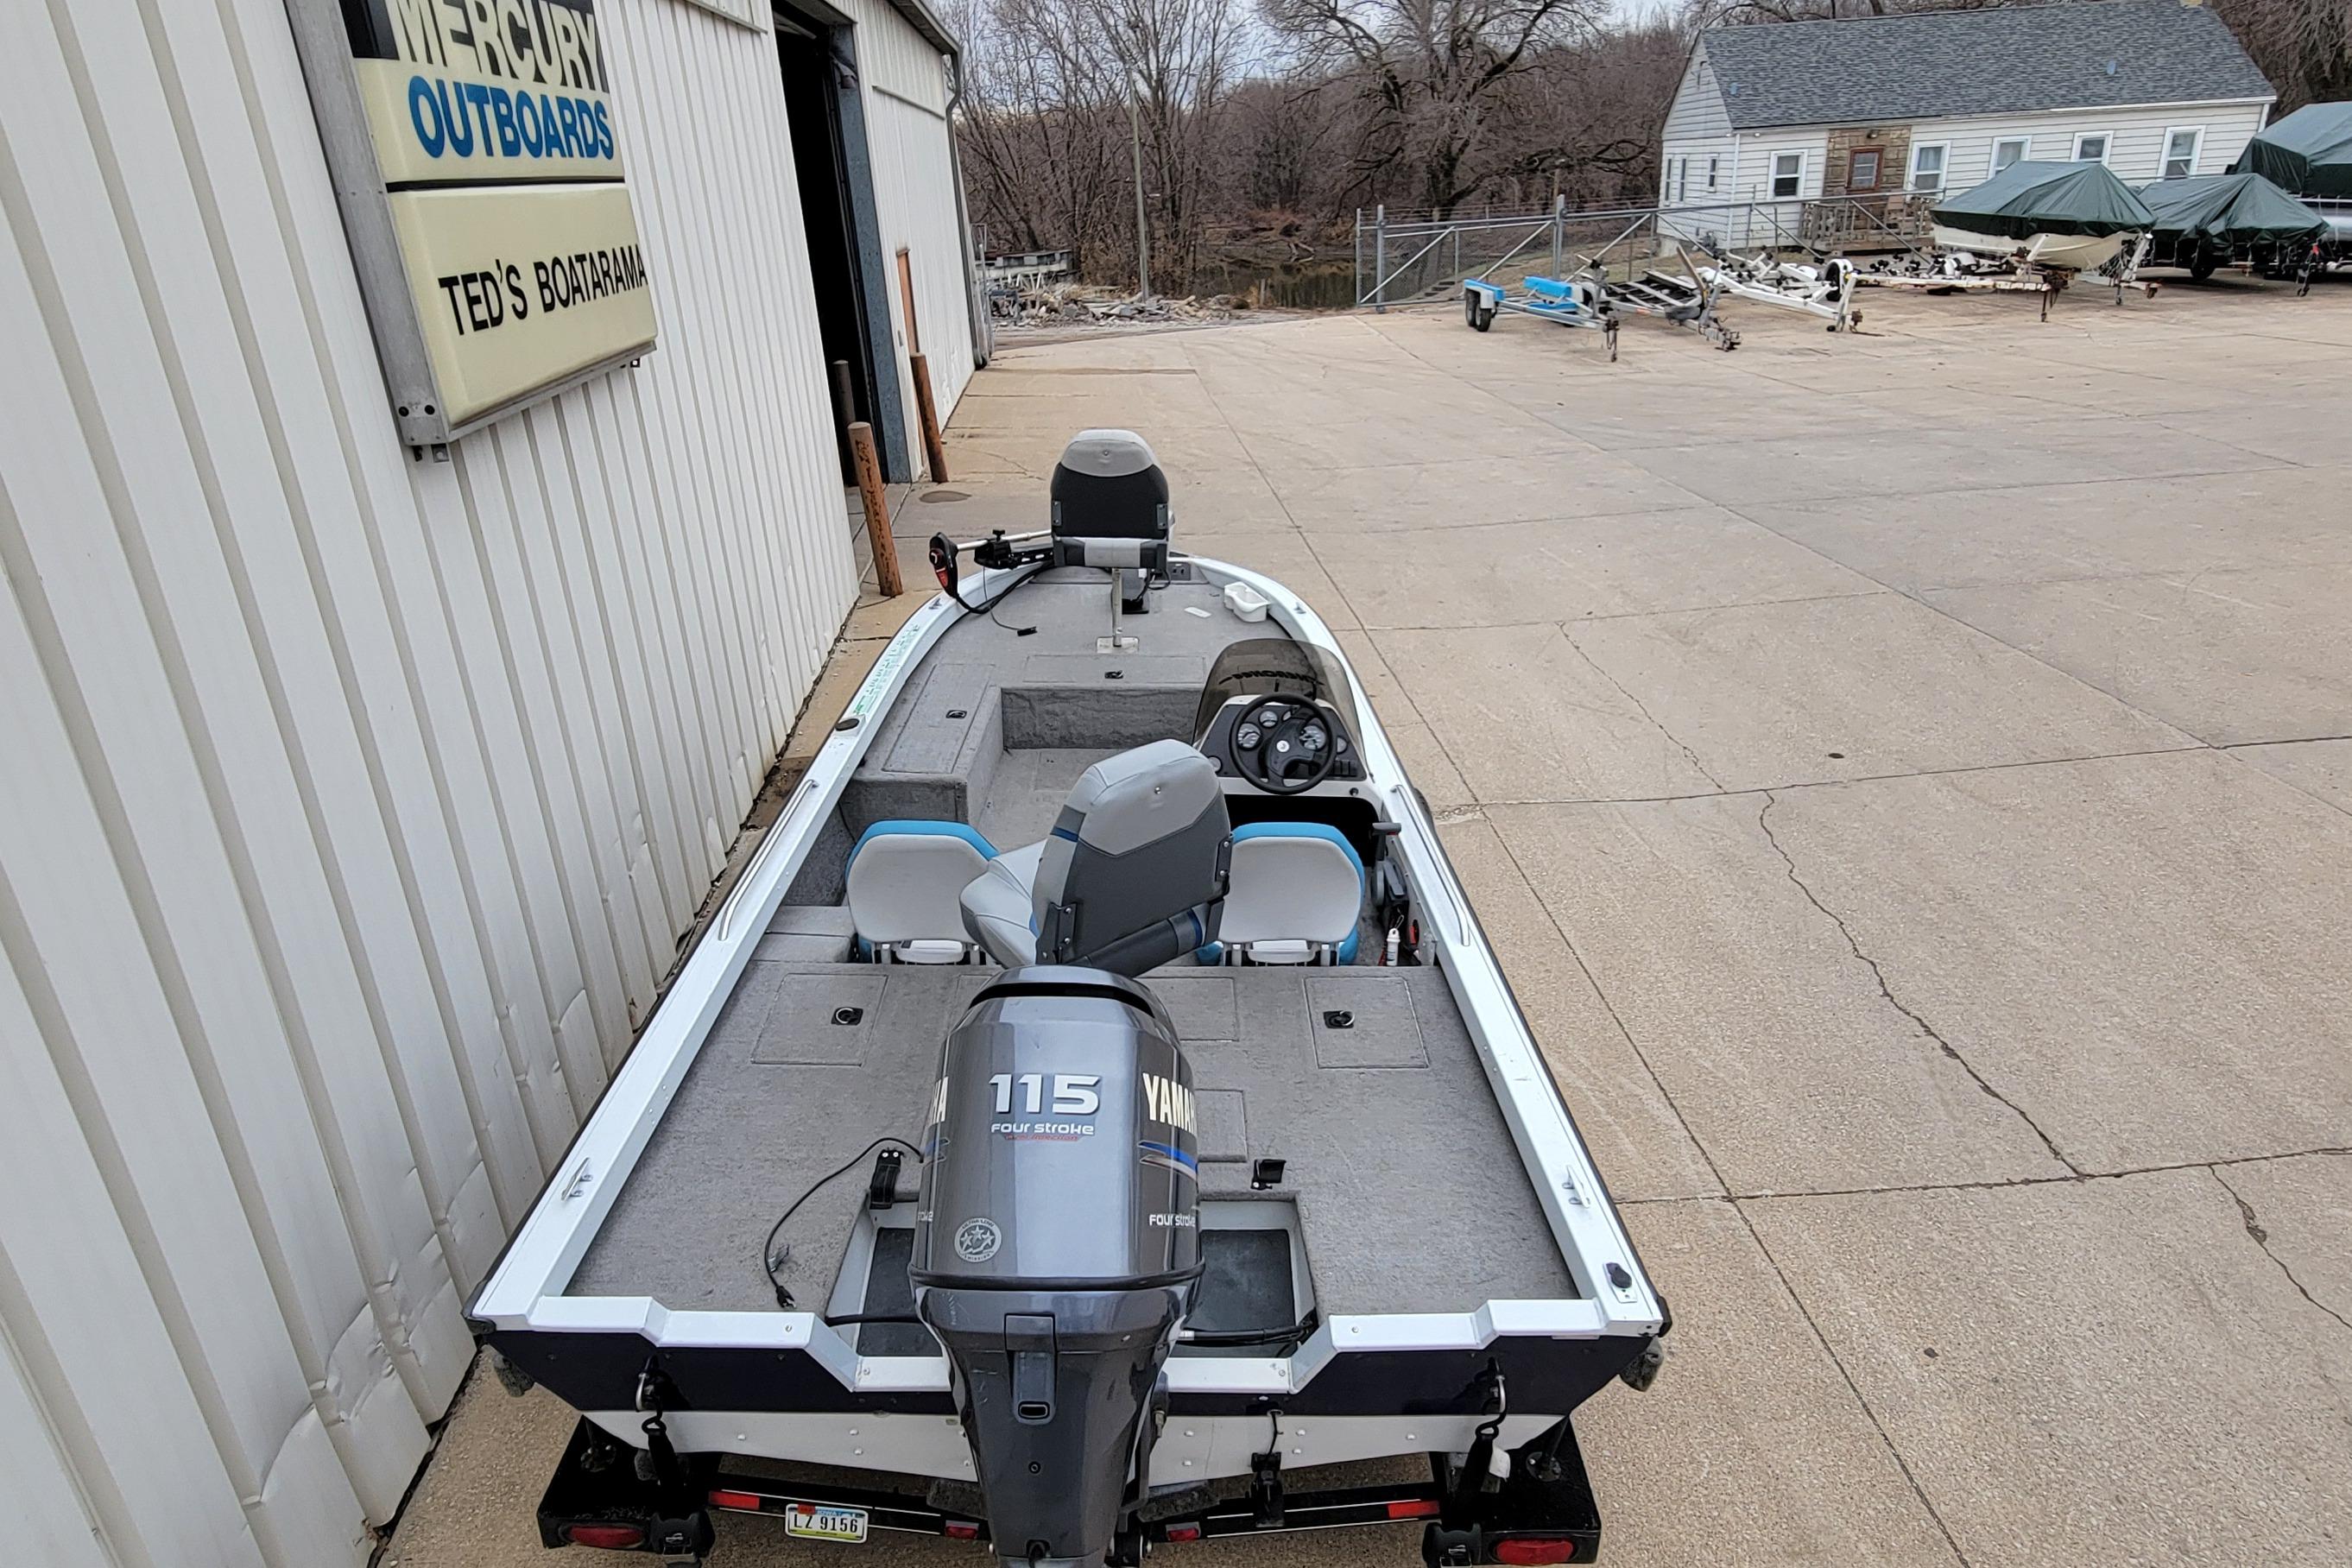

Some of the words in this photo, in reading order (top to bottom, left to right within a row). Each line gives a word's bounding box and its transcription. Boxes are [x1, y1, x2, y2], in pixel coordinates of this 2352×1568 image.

[387, 0, 610, 94] MERCURY
[408, 75, 614, 161] OUTBOARDS
[439, 259, 528, 336] TED'S
[534, 244, 648, 313] BOATARAMA
[989, 1073, 1102, 1115] 115
[1142, 1072, 1198, 1139] YAMAH
[819, 1516, 857, 1533] 9156
